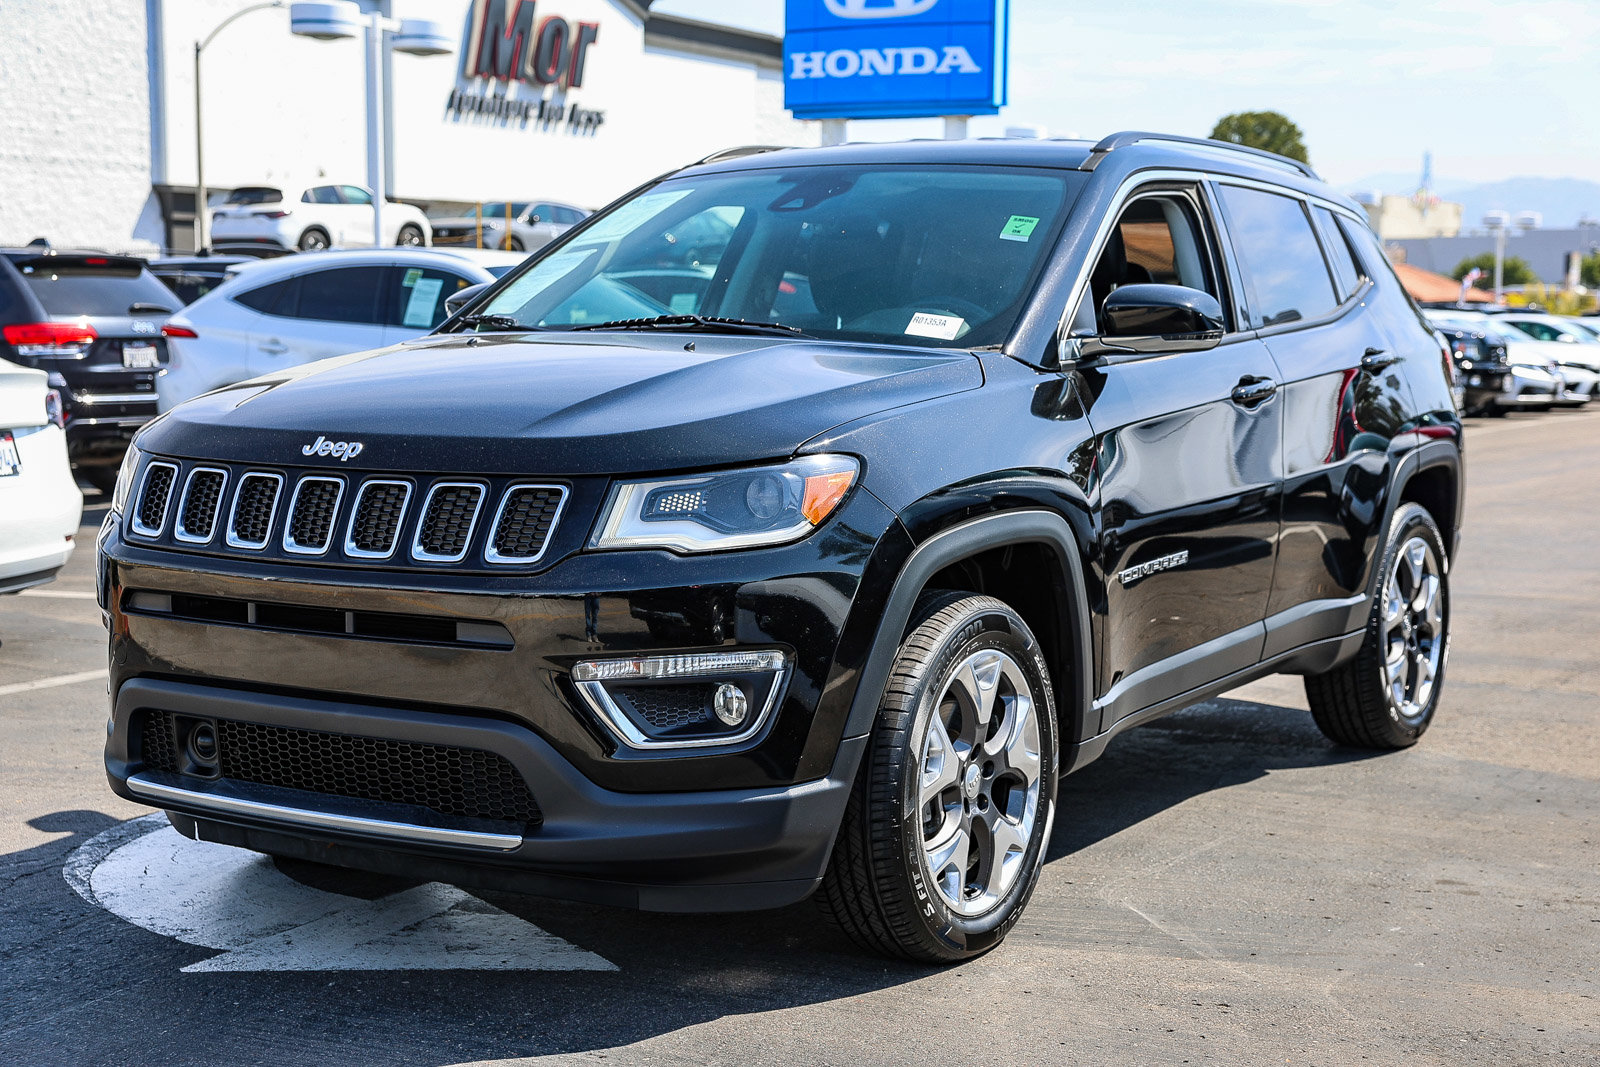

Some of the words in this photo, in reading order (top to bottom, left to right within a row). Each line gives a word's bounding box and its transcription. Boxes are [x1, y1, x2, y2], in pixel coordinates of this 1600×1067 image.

[468, 0, 599, 88] Mor
[789, 46, 981, 79] HONDA
[302, 436, 364, 461] Jeep
[1118, 550, 1188, 583] COMPASS
[912, 871, 927, 900] FIT
